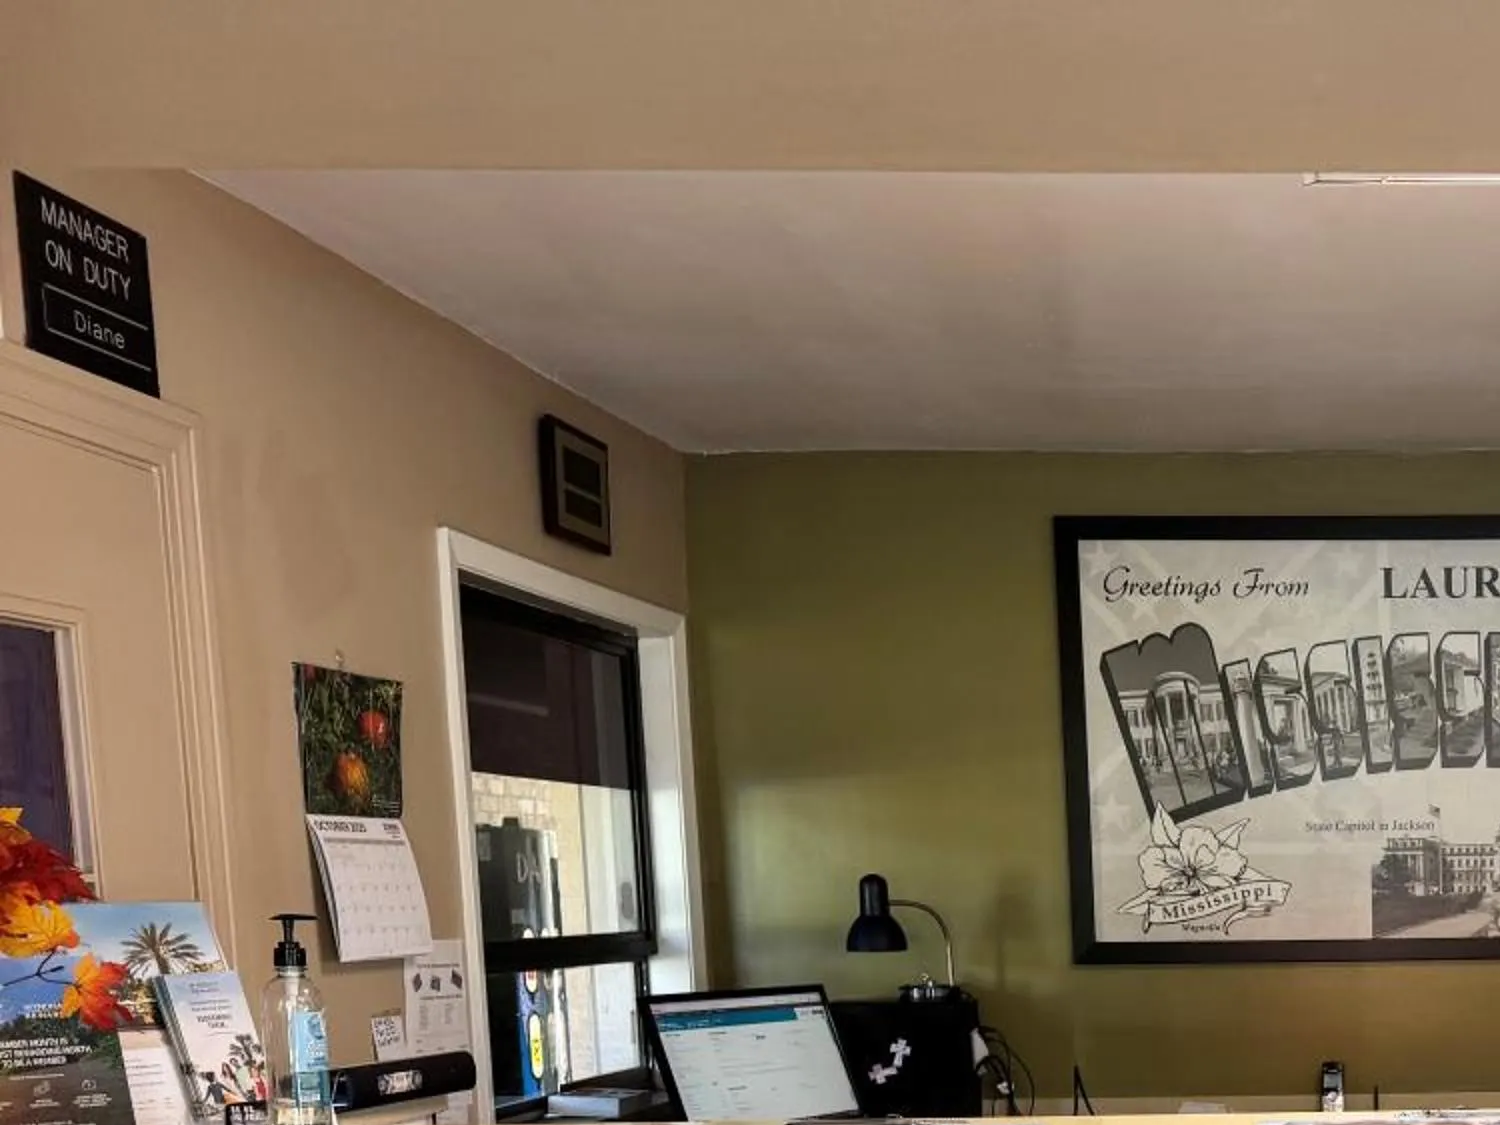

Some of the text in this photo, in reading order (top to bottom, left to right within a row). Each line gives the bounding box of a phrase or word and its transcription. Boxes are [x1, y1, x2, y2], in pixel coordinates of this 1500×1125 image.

[41, 196, 129, 264] MANAGER
[45, 240, 131, 301] ON DUTY
[74, 310, 126, 349] Diane
[1103, 565, 1309, 604] Greetings From
[1305, 820, 1333, 832] State
[1335, 820, 1376, 834] Capitol
[1391, 819, 1436, 832] Jackson
[1161, 883, 1273, 920] Mississippi
